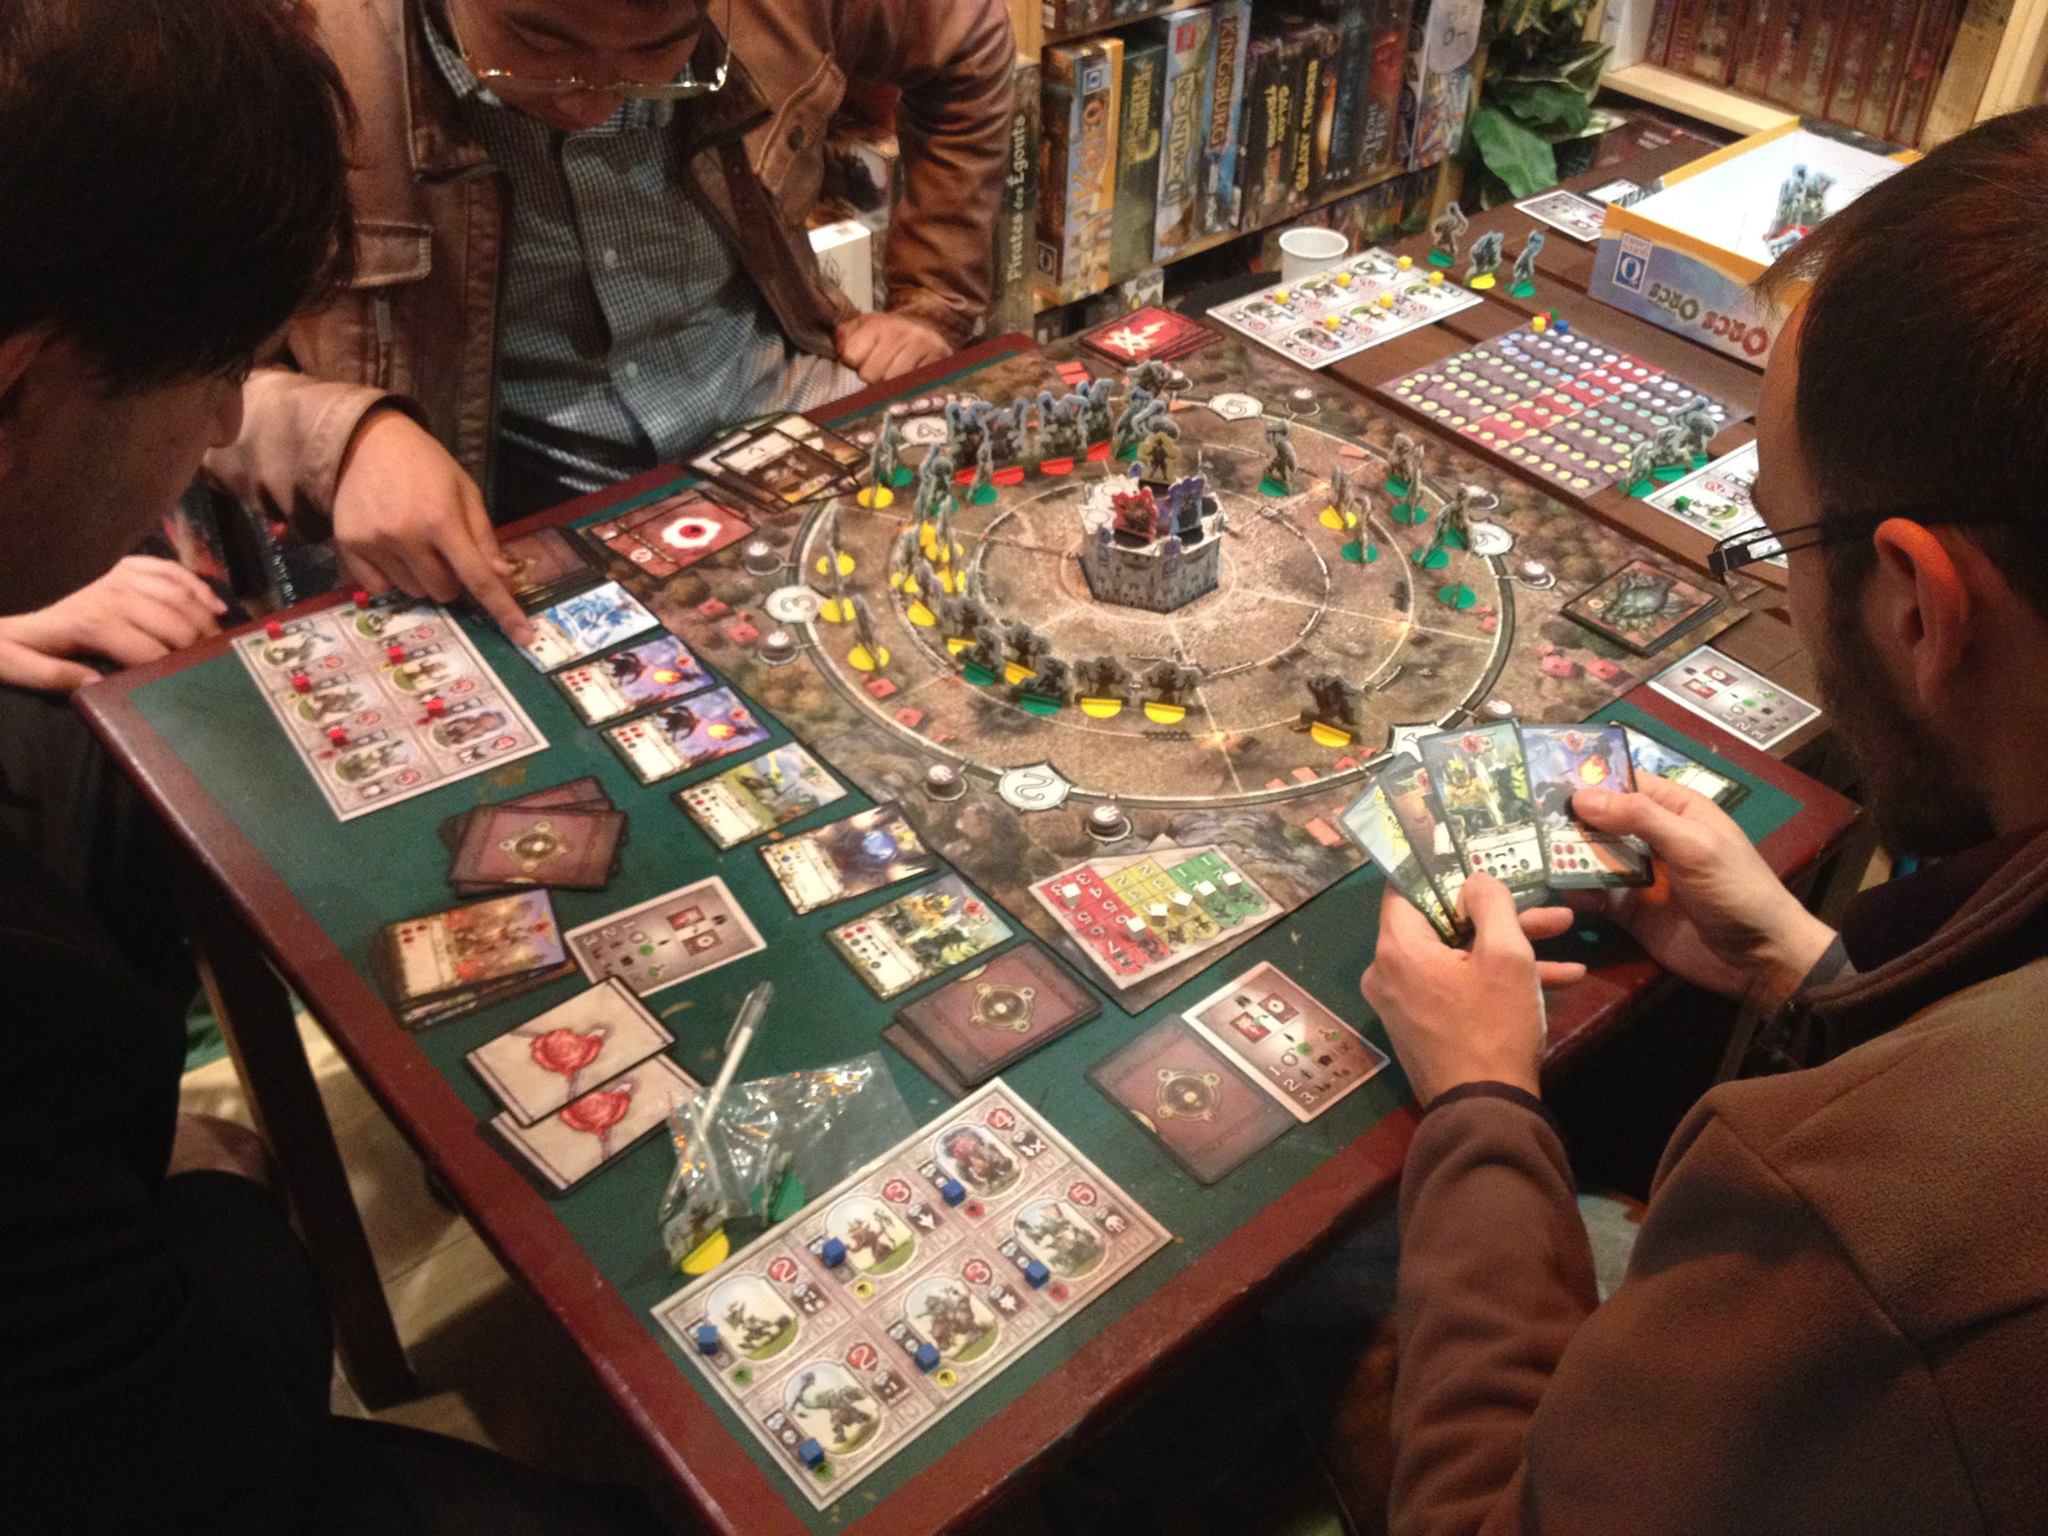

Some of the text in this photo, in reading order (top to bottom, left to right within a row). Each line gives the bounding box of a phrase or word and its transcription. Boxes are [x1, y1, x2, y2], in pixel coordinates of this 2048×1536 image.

[1209, 18, 1238, 149] KINGSBURG
[1008, 211, 1024, 282] Pirates
[1014, 772, 1055, 801] 2
[885, 1181, 910, 1202] 3
[1071, 1184, 1096, 1205] 5
[771, 1259, 797, 1282] 2
[966, 1261, 991, 1283] 3
[850, 1344, 877, 1370] 2
